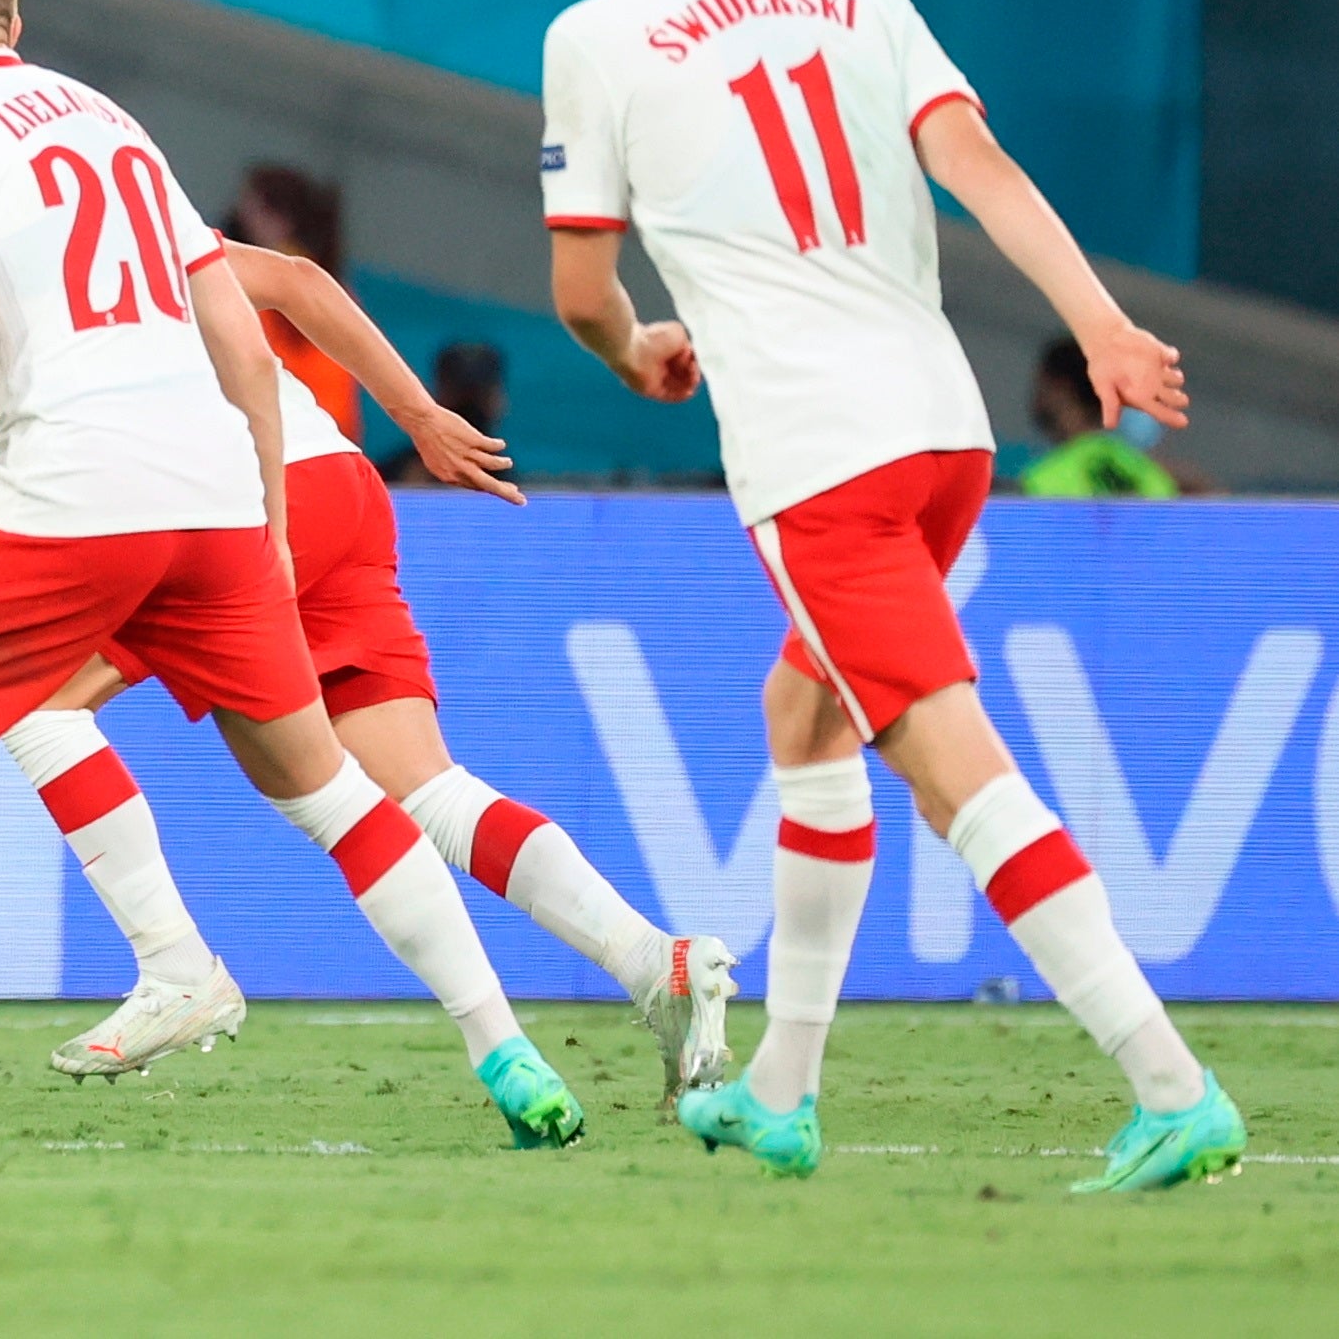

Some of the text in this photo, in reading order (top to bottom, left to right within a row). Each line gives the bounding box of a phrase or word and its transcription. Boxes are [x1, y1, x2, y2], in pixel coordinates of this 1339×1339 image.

[29, 145, 192, 332] 20
[728, 49, 867, 255] 11
[566, 524, 1339, 965] viv
